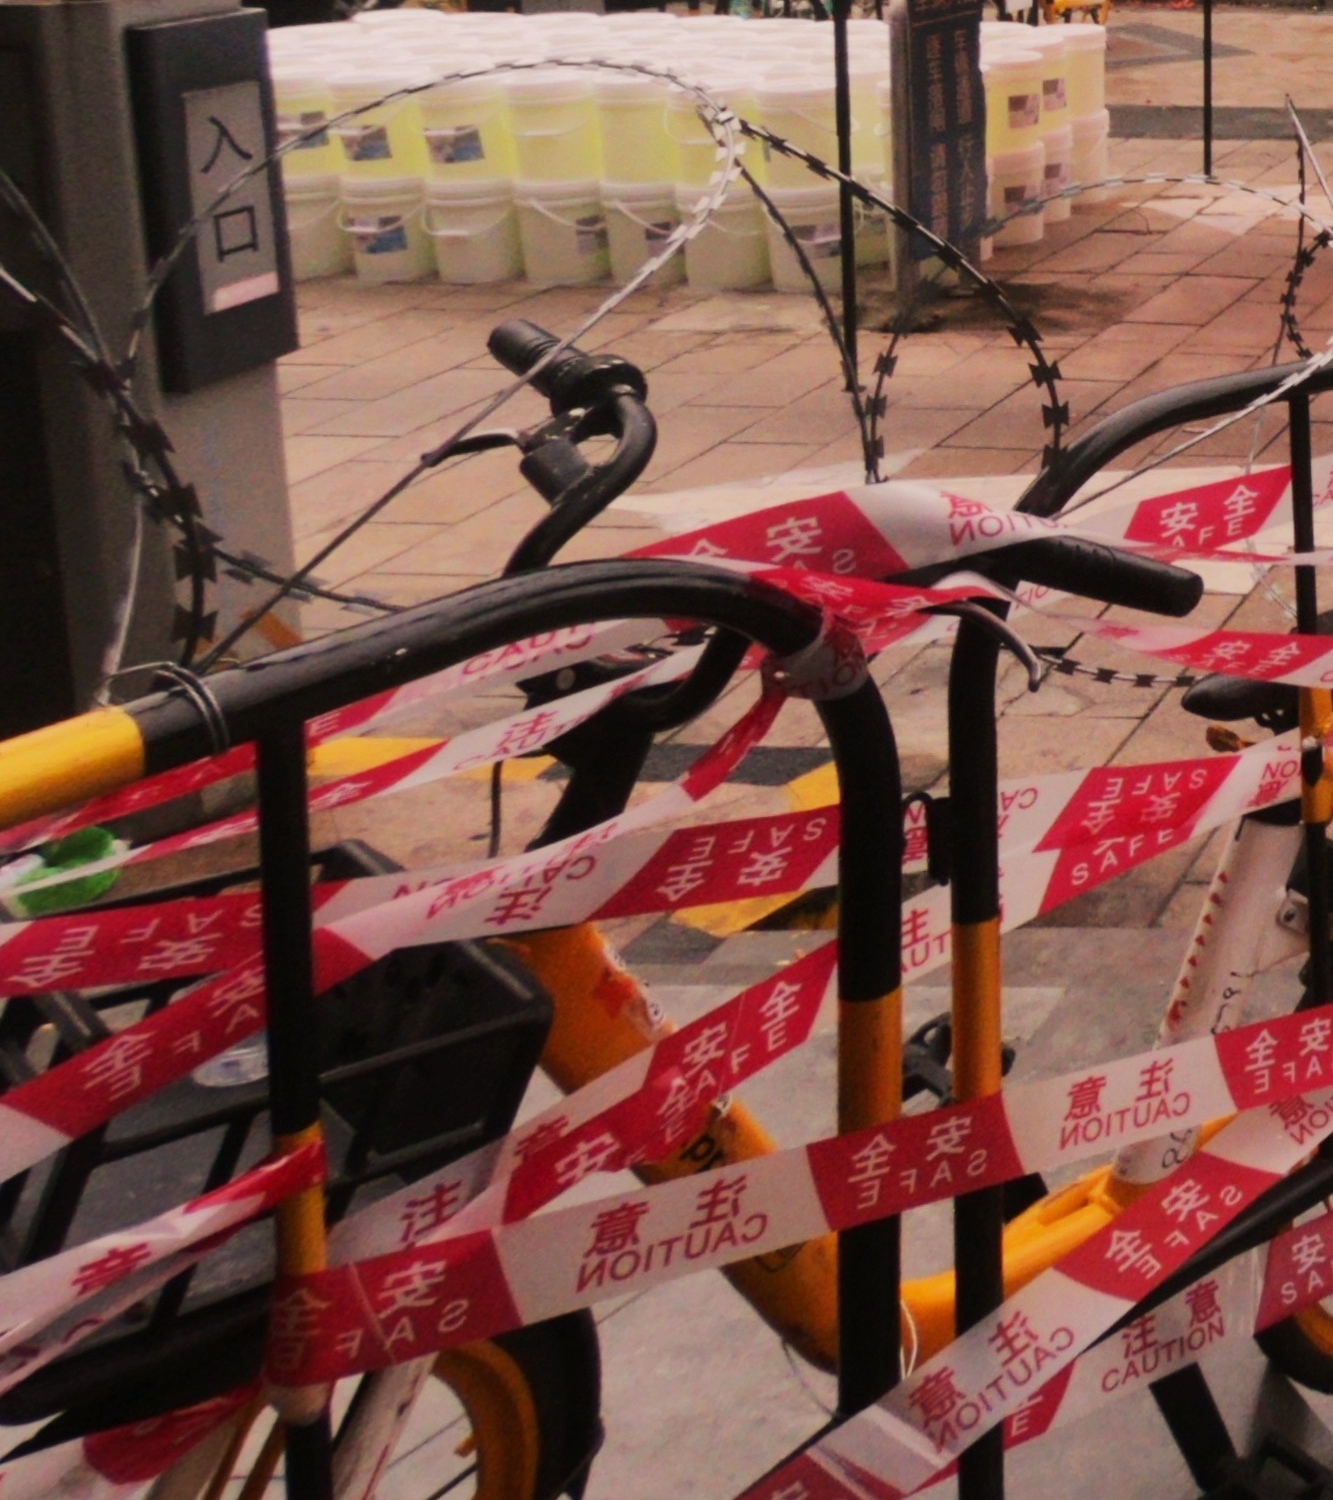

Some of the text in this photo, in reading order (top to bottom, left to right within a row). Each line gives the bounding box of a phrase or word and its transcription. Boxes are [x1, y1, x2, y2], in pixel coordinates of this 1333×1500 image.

[201, 116, 258, 263] 入口
[1159, 484, 1259, 539] 安全
[1172, 523, 1243, 550] AFE
[1212, 639, 1300, 667] 安全
[1102, 768, 1207, 799] SAFE
[687, 817, 827, 862] SAFE
[1081, 792, 1181, 835] 安全
[656, 846, 793, 903] 安全
[1071, 829, 1174, 886] SAFE
[6, 932, 224, 989] 安全
[683, 980, 803, 1079] 安全
[1122, 1279, 1223, 1360] 注意
[1101, 1316, 1226, 1394] CAUTION
